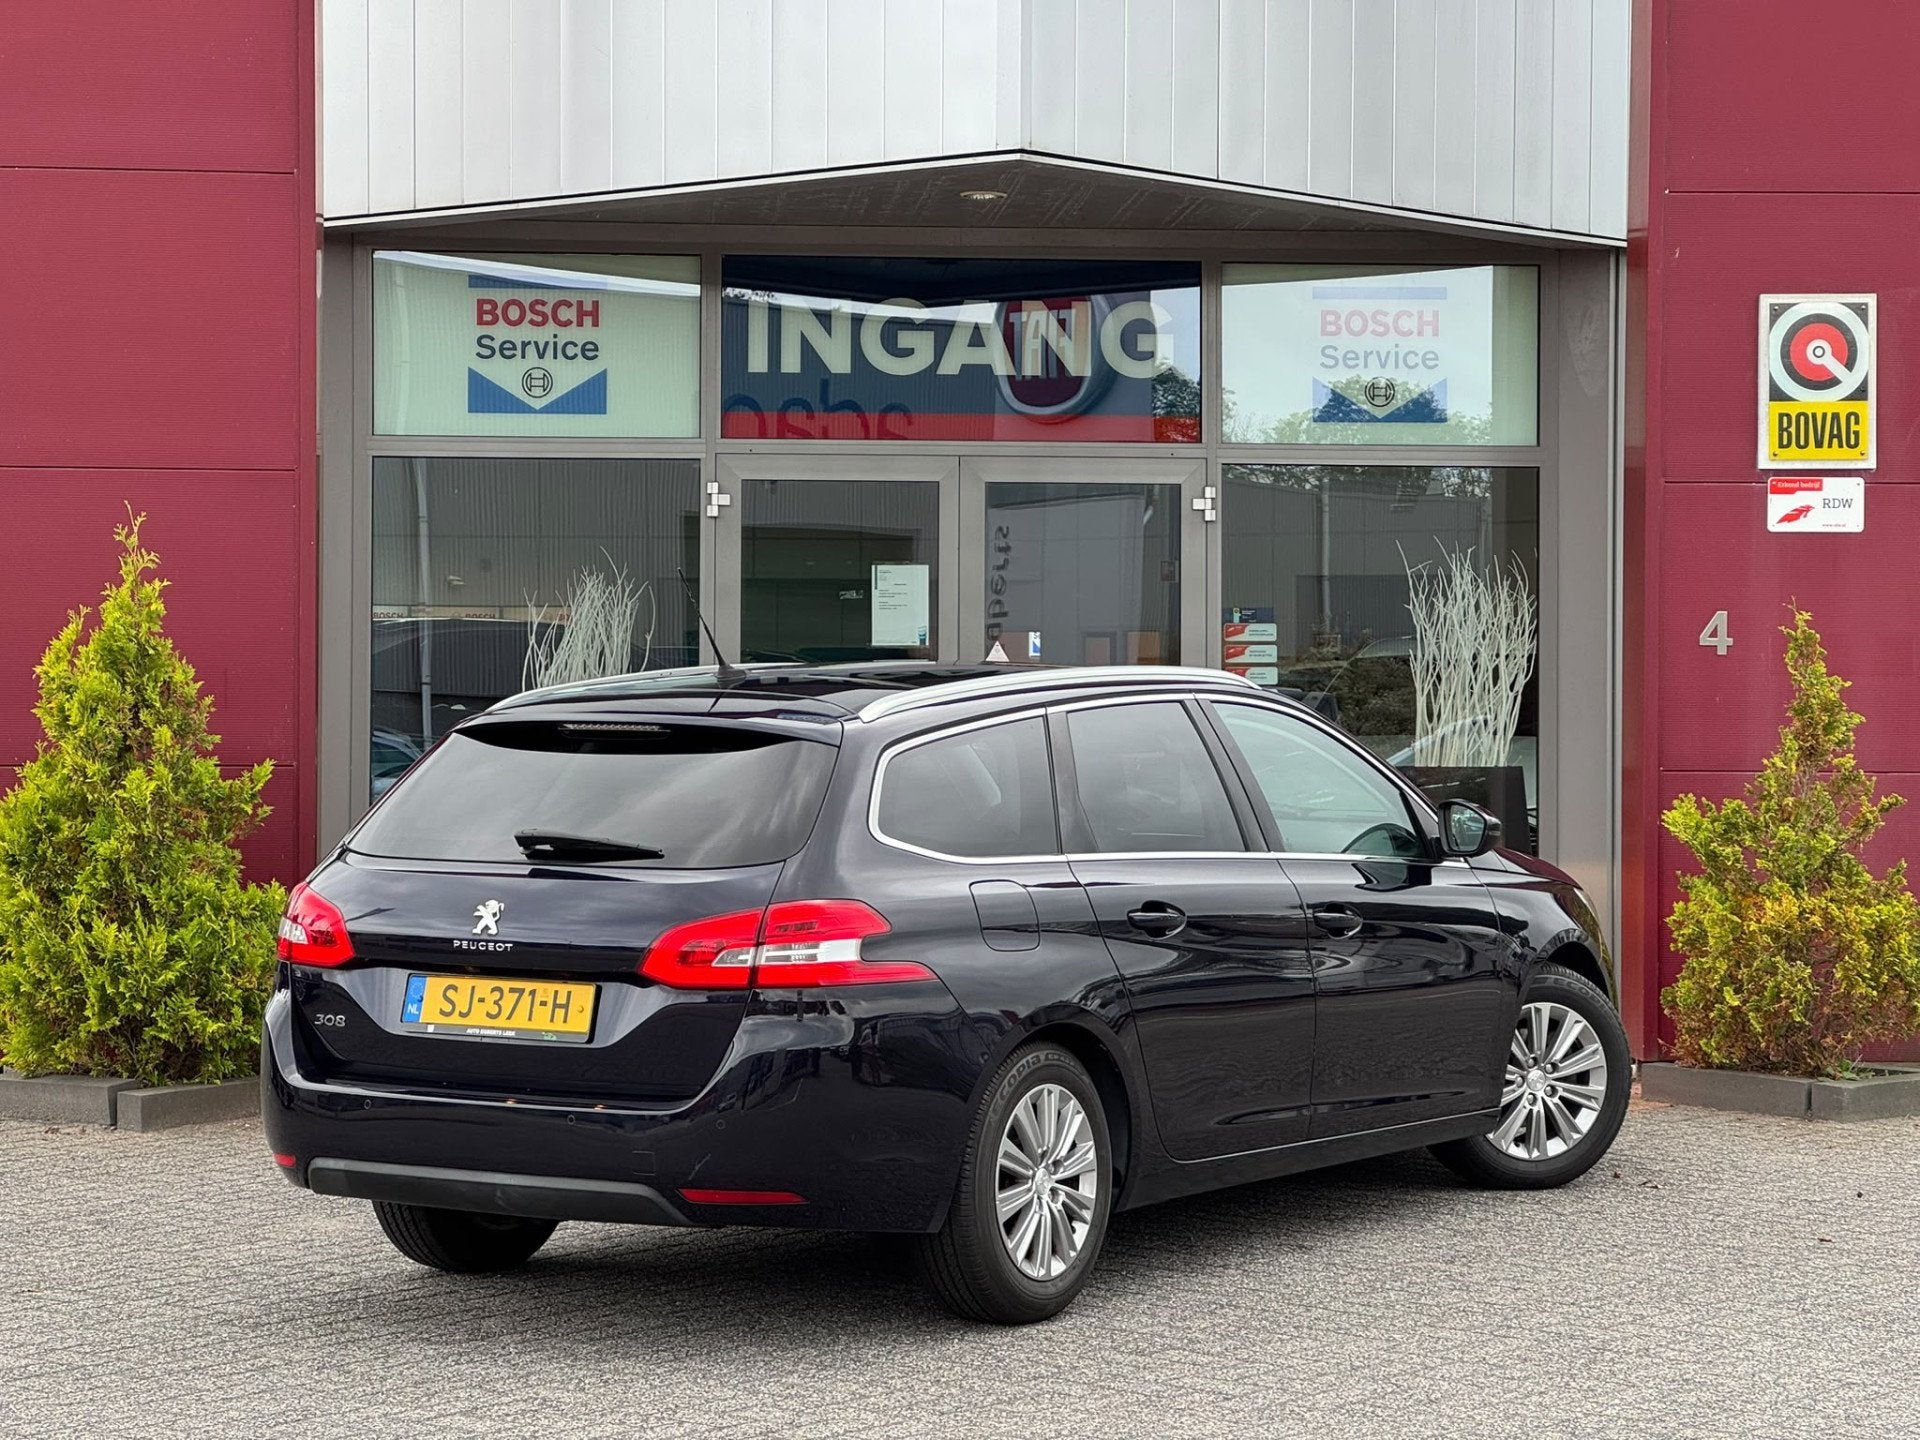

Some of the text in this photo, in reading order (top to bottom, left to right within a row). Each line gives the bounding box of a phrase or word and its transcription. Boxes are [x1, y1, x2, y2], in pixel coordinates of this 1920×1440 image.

[476, 298, 600, 328] BOSCH
[1320, 309, 1440, 338] BOSCH
[475, 334, 600, 361] Service
[747, 297, 1175, 379] INGANG
[1320, 344, 1440, 370] Service
[1777, 411, 1861, 450] BOVAG
[1822, 498, 1853, 509] RDW
[1699, 610, 1734, 656] 4
[453, 940, 513, 952] PEUGEOT
[407, 1003, 419, 1015] NL
[438, 983, 573, 1024] SJ-371-H
[314, 1013, 346, 1028] 308
